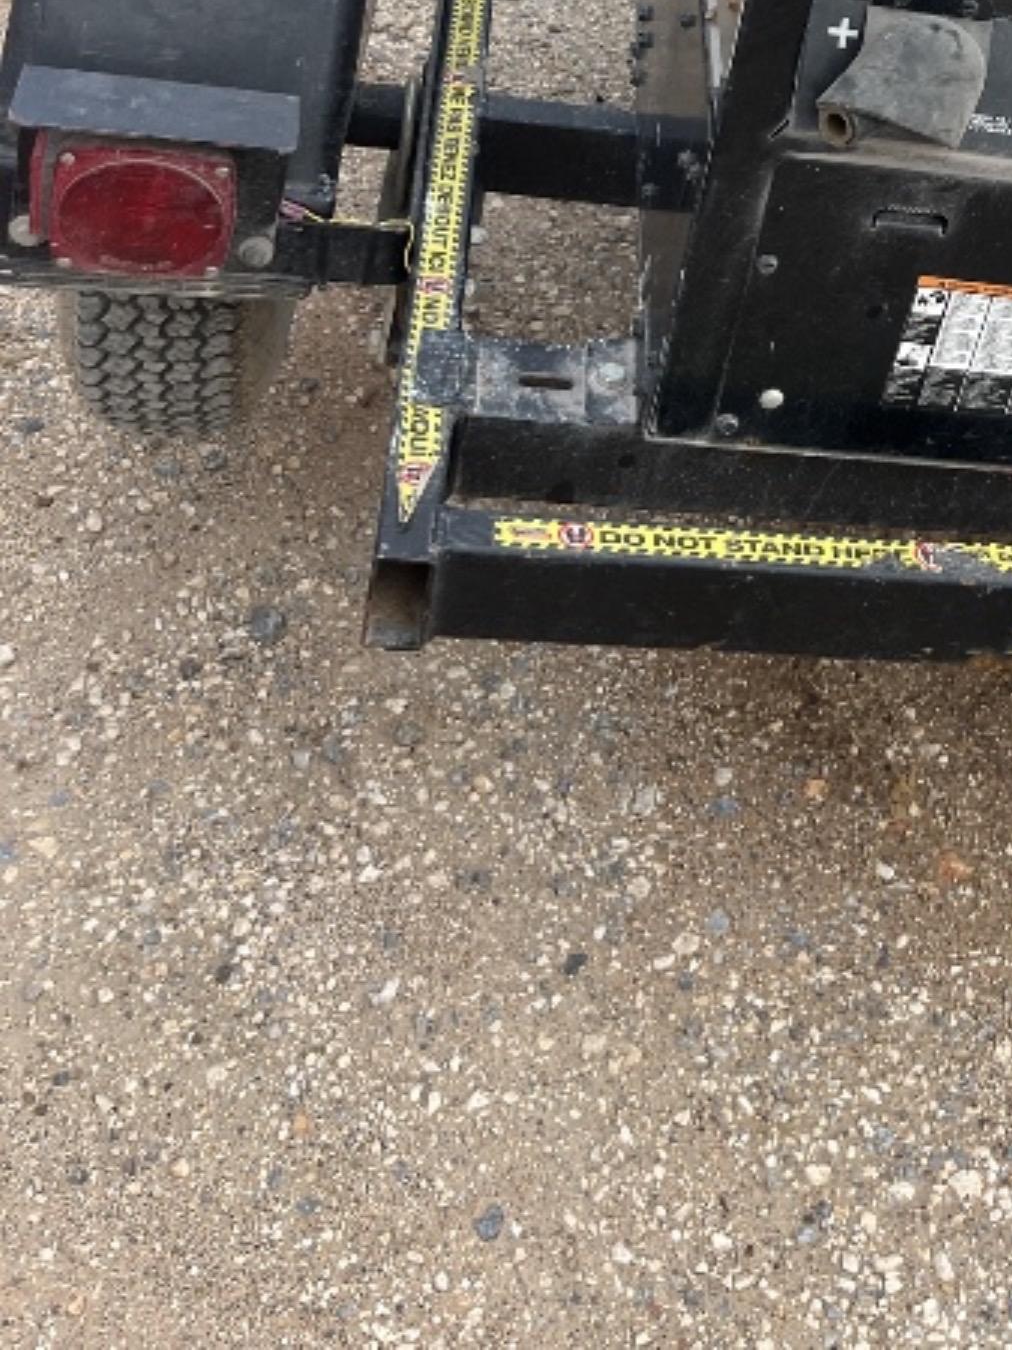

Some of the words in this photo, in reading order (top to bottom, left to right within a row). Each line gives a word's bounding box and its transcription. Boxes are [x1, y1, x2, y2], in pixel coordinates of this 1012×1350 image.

[600, 530, 646, 546] DO
[653, 533, 718, 550] NOT
[725, 537, 827, 558] STAND
